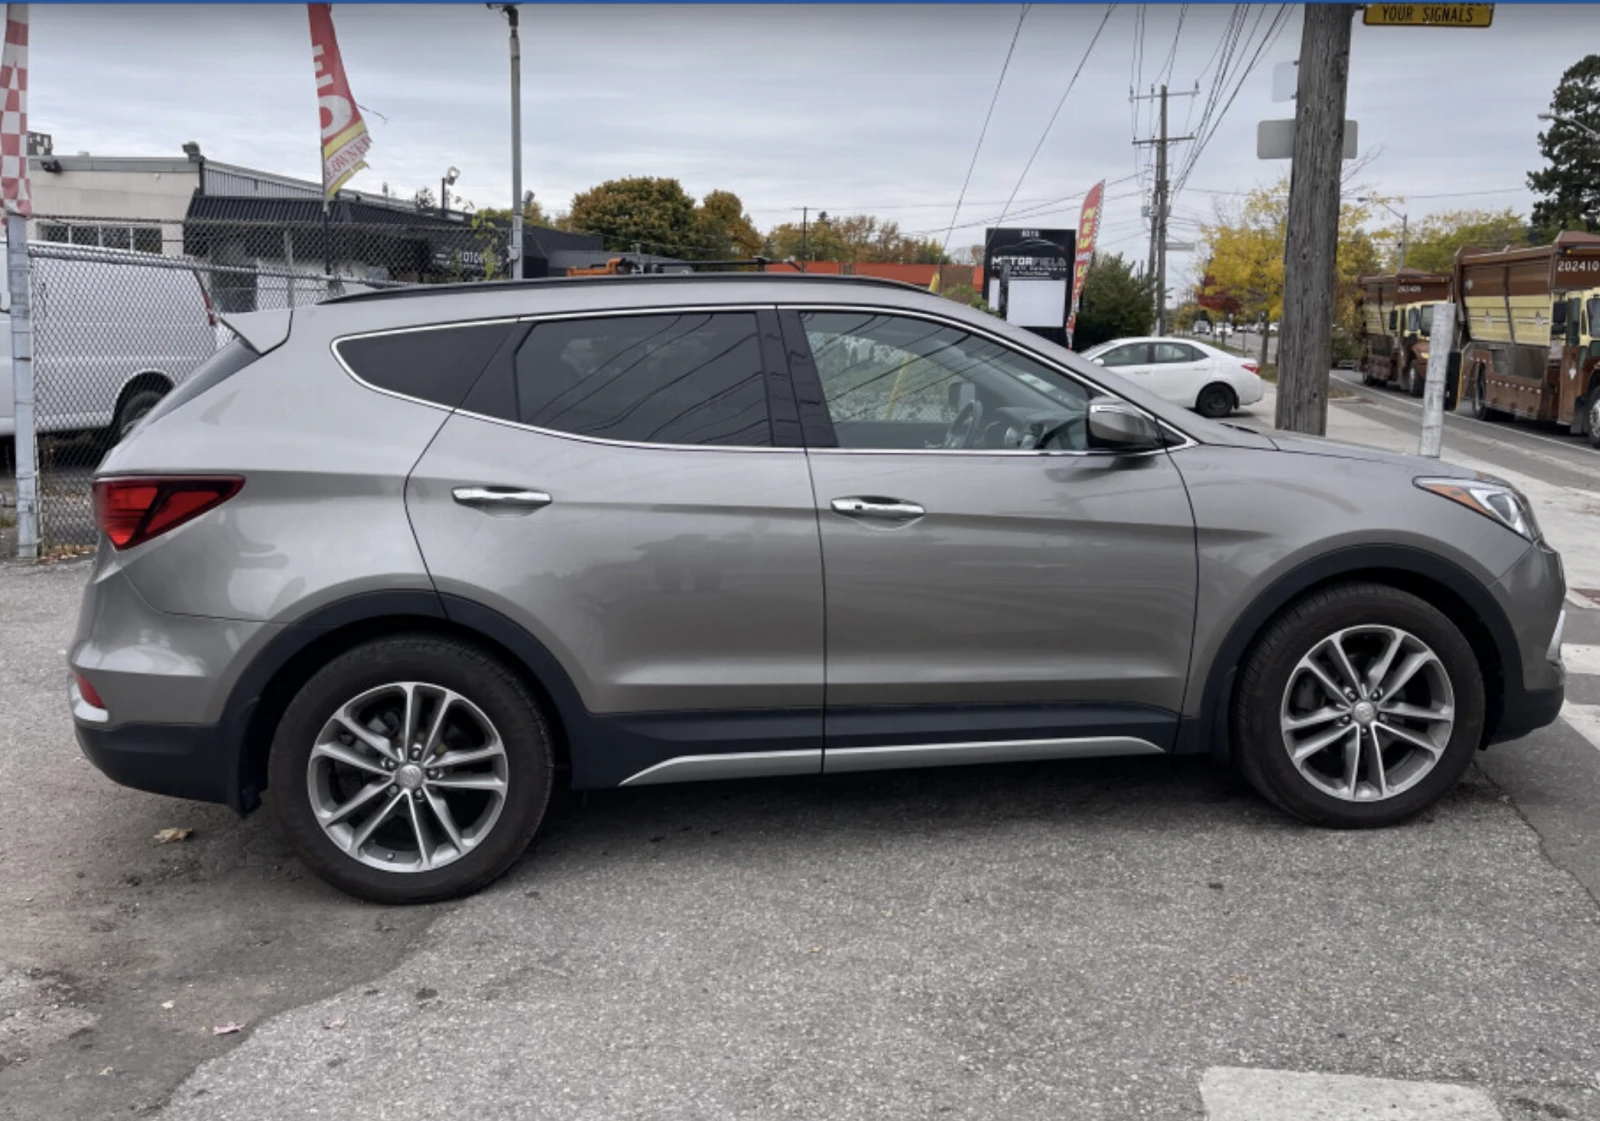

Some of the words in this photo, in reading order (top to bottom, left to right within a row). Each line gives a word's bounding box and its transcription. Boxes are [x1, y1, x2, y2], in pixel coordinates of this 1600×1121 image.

[1382, 5, 1413, 21] YOUR
[1422, 6, 1473, 23] SIGNALS
[1079, 207, 1097, 248] NEW
[1557, 260, 1600, 272] 202410
